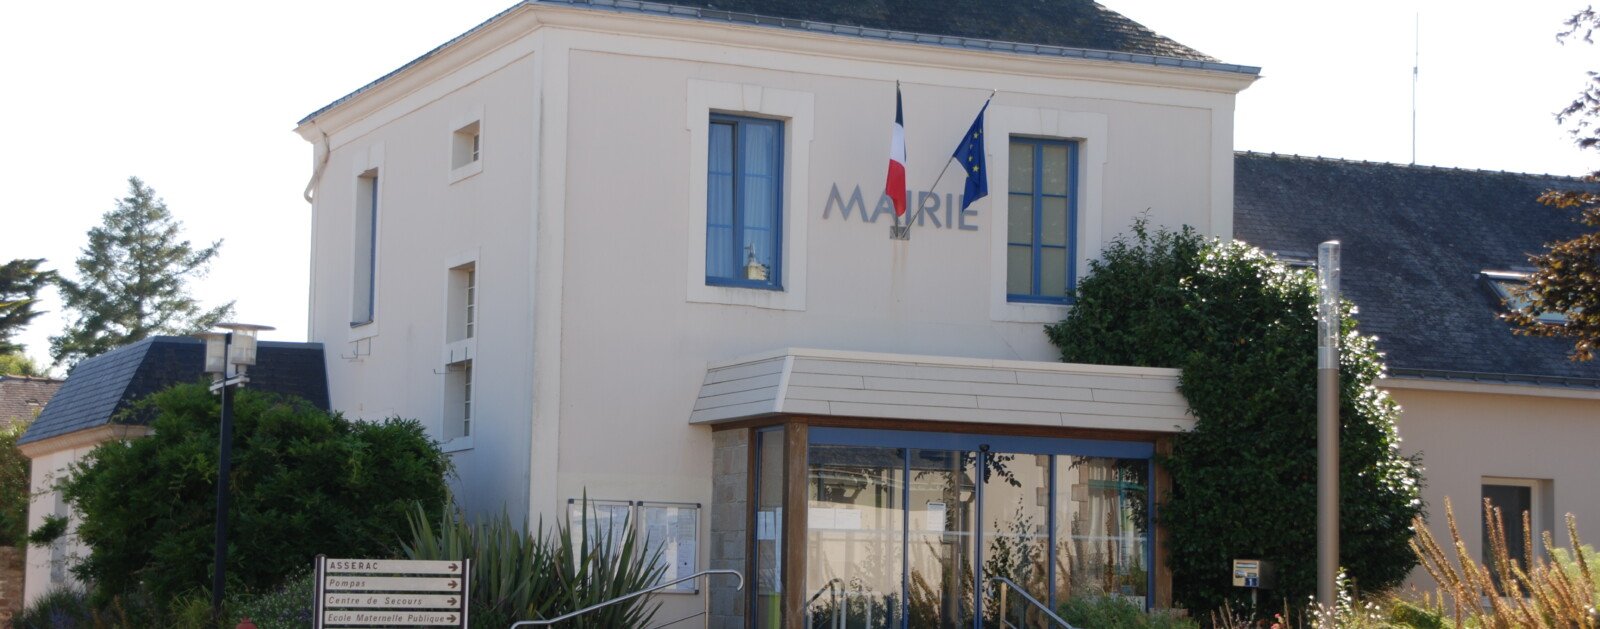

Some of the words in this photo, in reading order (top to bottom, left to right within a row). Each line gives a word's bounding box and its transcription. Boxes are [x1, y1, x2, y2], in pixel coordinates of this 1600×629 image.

[822, 182, 978, 231] MAIRIE
[329, 561, 379, 570] ASSERAC
[329, 579, 366, 587] Pompas
[328, 596, 360, 605] Centre
[367, 597, 378, 605] de
[384, 597, 423, 606] Secours
[327, 613, 351, 622] Ecole
[356, 614, 403, 622] Maternelle
[407, 614, 445, 624] Publique
